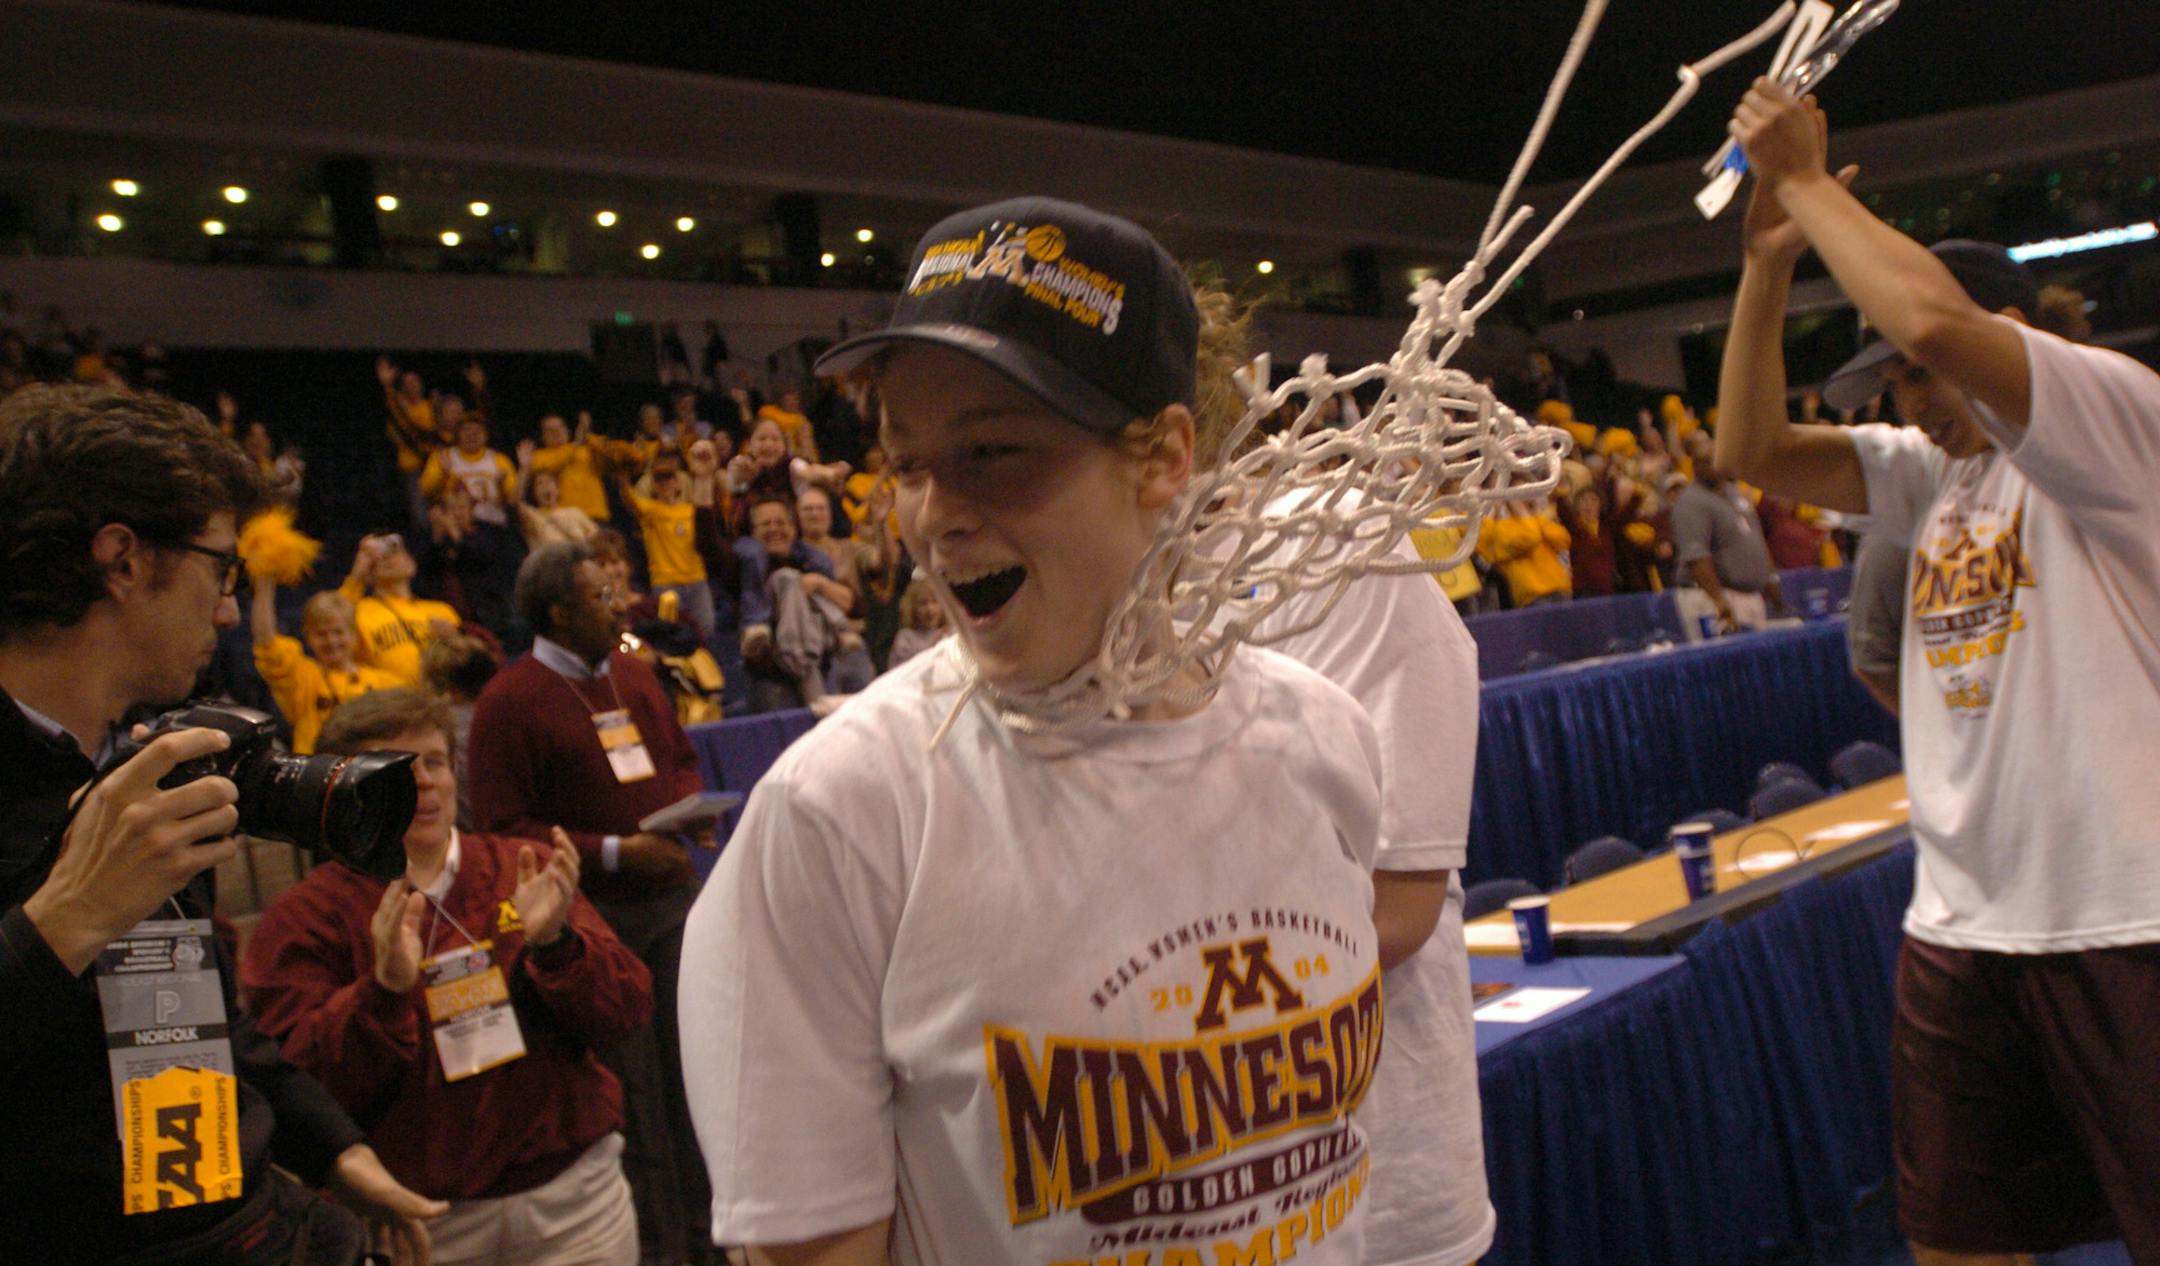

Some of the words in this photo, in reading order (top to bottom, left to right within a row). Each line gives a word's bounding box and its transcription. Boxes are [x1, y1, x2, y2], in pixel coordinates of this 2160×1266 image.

[1031, 262, 1124, 336] CHAMPIONS
[1150, 914, 1239, 961] WOMEN'S
[1252, 908, 1359, 957] BASKETBALL
[154, 990, 181, 1024] P
[1150, 984, 1196, 1014] 20
[1294, 954, 1332, 982] 04
[1195, 936, 1305, 1033] M
[135, 1026, 198, 1045] NORFOLK
[128, 1080, 144, 1184] CHAMPIONSHIPS
[215, 1077, 230, 1175] CHAMPIONSHIPS
[1132, 1167, 1256, 1215] GOLDEN
